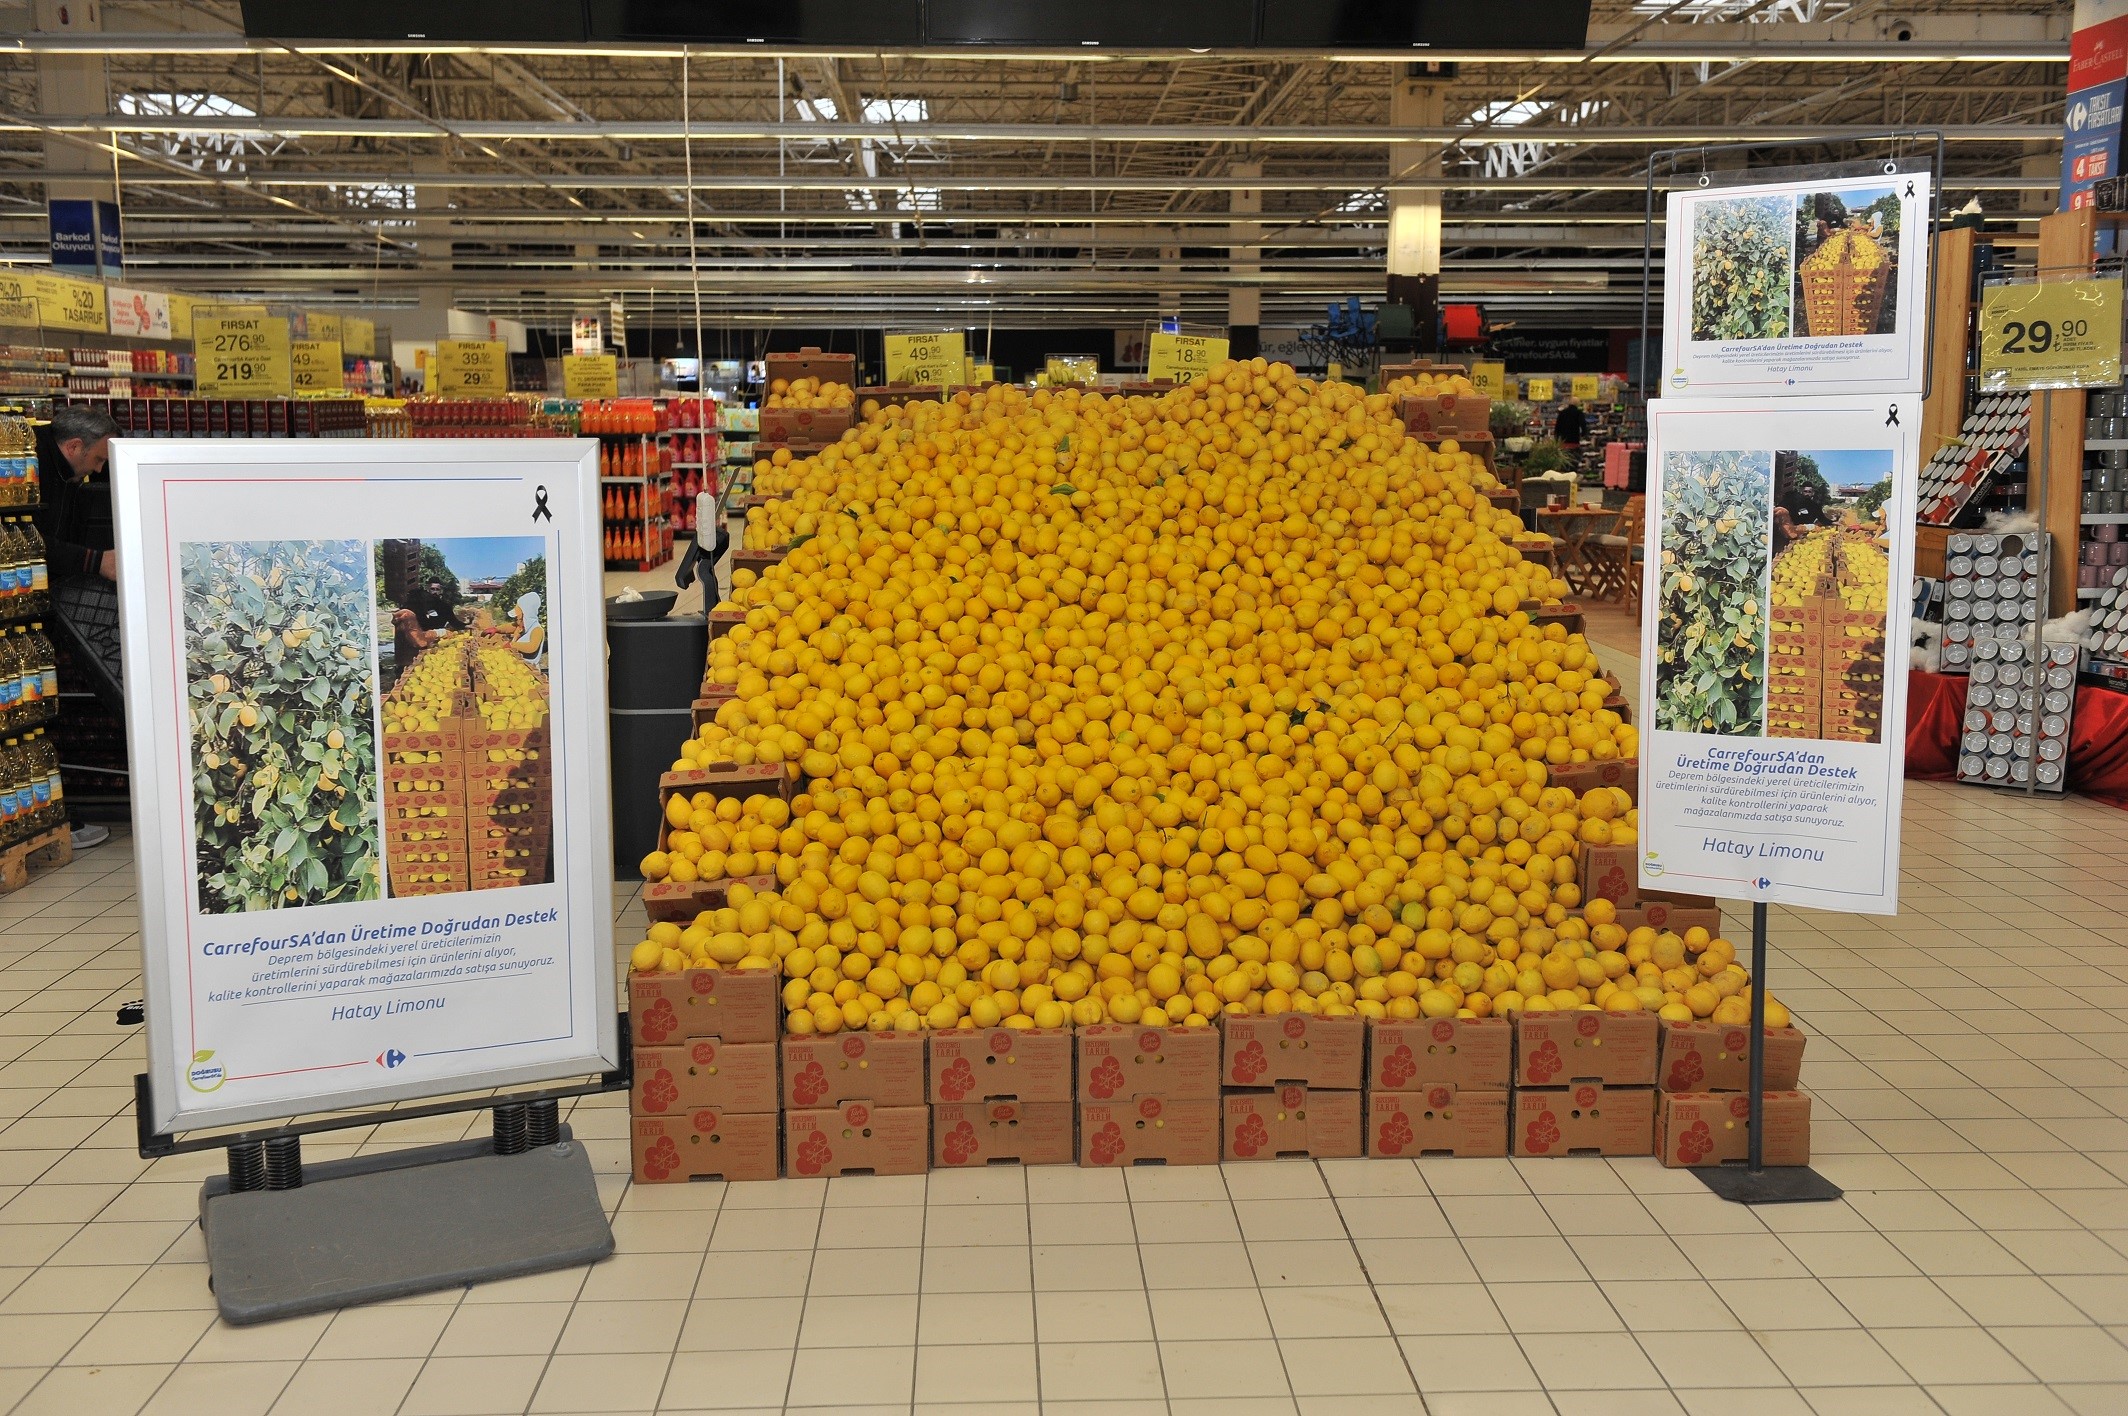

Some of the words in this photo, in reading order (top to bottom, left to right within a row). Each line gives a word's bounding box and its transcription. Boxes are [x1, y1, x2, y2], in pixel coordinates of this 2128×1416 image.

[2076, 158, 2085, 178] 4
[52, 242, 94, 252] Okuyucu
[55, 233, 90, 242] Barkod
[73, 290, 93, 308] %20
[63, 308, 102, 324] TASARRUF
[221, 320, 259, 329] FIRSAT
[1176, 337, 1206, 346] FIRSAT
[1708, 748, 1824, 763] CarrefourSA'dan
[1677, 754, 1730, 771] Üretime
[1733, 761, 1803, 775] Doğrudan
[1808, 764, 1858, 779] Destek
[1668, 770, 1703, 780] Deprem
[1706, 773, 1765, 785] bölgesindeki
[1766, 778, 1791, 787] yerel
[1793, 778, 1864, 792] üreticilerimizin
[1656, 781, 1708, 792] üretimlerini
[1710, 786, 1779, 798] sürdürebilmesi
[1780, 789, 1797, 799] için
[1800, 790, 1846, 803] ürünlerini
[1848, 795, 1877, 807] alıyor,
[1701, 796, 1727, 806] kalite
[1729, 798, 1788, 810] kontrollerini
[1788, 803, 1828, 813] yaparak
[1684, 807, 1762, 820] mağazalarımızda
[1764, 813, 1792, 823] satışa
[1794, 815, 1844, 827] sunuyoruz.
[1703, 837, 1754, 858] Hatay
[1759, 842, 1824, 861] Limonu
[203, 930, 346, 956] CarrefourSA'dan
[351, 924, 417, 941] Üretime
[421, 916, 500, 936] Doğrudan
[505, 908, 558, 926] Destek
[268, 953, 313, 966] Deprem
[317, 945, 388, 960] bölgesindeki
[389, 940, 418, 955] yerel
[421, 934, 501, 950] üreticilerimizin
[252, 965, 320, 982] üretimlerini
[322, 956, 405, 974] sürdürebilmesi
[408, 955, 426, 967] için
[430, 949, 482, 963] ürünlerini
[484, 946, 516, 957] alıyor,
[208, 990, 242, 1002] kalite
[245, 980, 317, 998] kontrollerini
[318, 975, 365, 991] yaparak
[369, 965, 462, 985] mağazalarımızda
[464, 963, 496, 974] satışa
[499, 956, 554, 971] sunuyoruz.
[331, 1003, 382, 1020] Hatay
[386, 997, 446, 1014] Limonu
